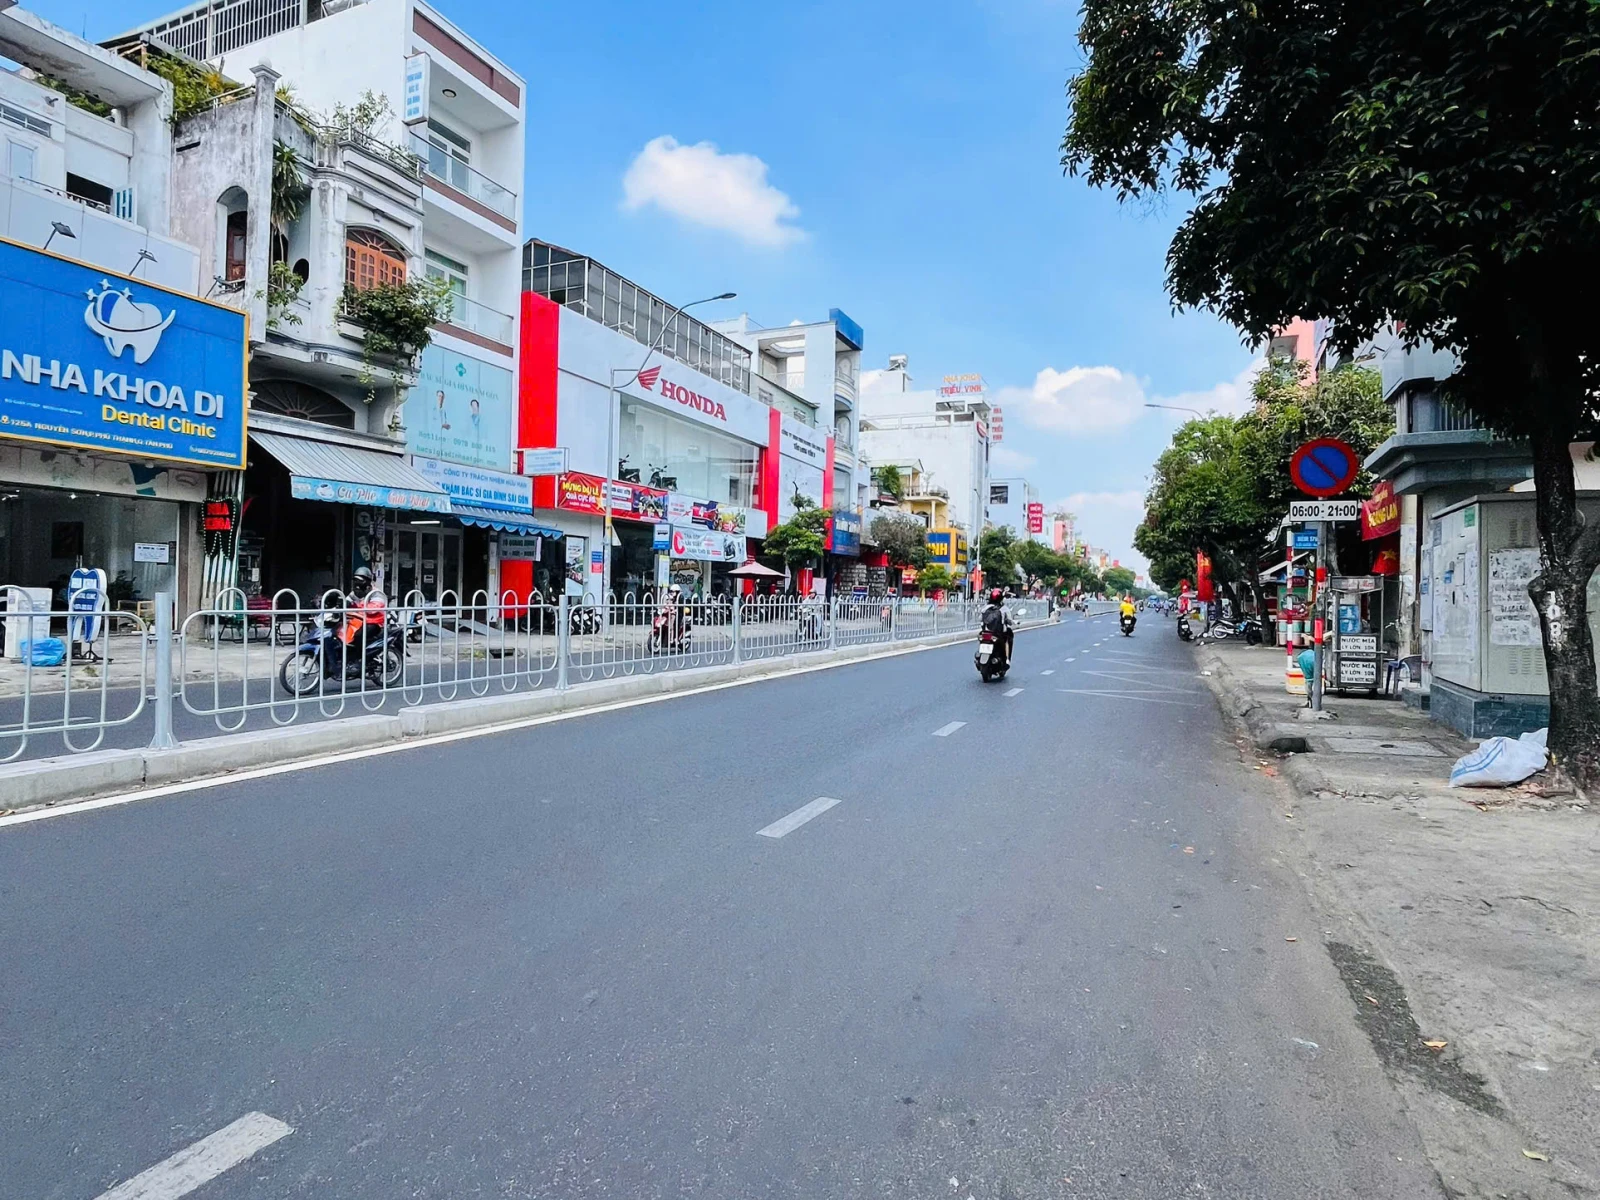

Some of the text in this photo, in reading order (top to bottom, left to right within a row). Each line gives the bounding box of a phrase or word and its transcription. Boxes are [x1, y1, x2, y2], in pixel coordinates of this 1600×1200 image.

[2, 350, 88, 393] NHA
[94, 369, 188, 412] KHOA
[660, 378, 727, 421] HONDA
[102, 404, 164, 430] Dental
[168, 416, 216, 439] Clinic
[462, 485, 473, 496] BÁC
[483, 489, 492, 499] GIA
[1292, 505, 1319, 516] 06:00
[1327, 505, 1356, 516] 21:00
